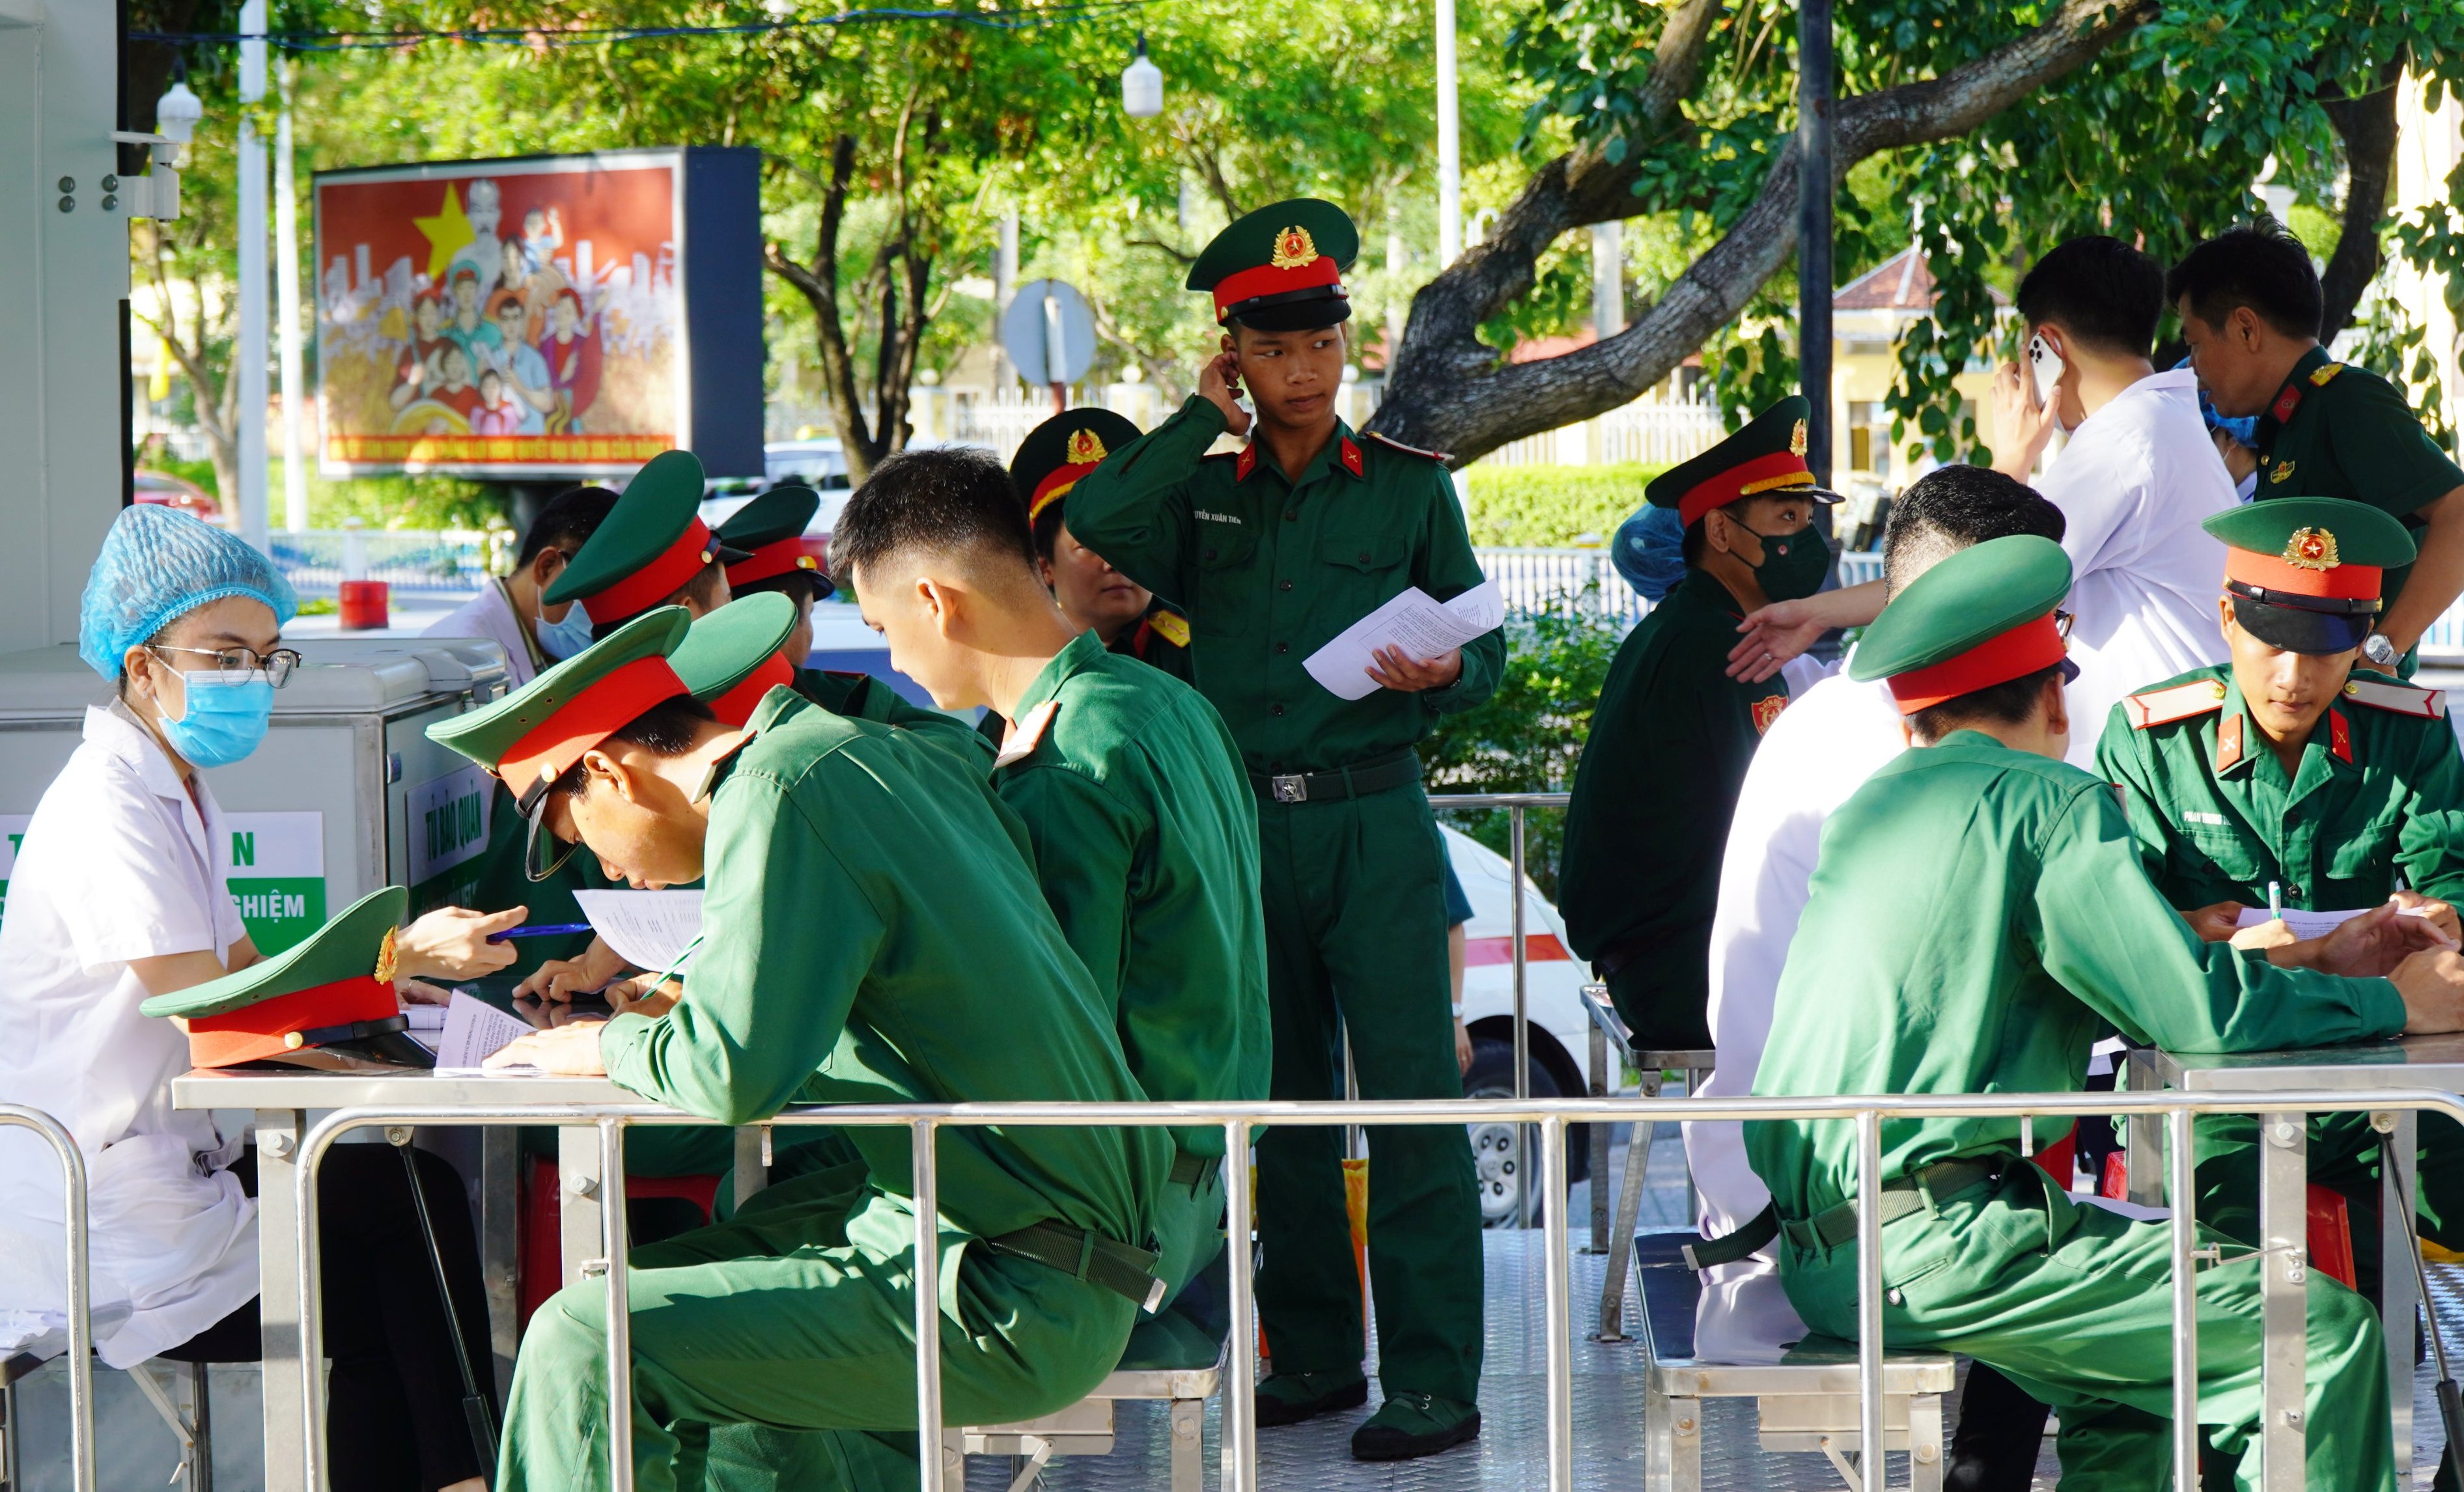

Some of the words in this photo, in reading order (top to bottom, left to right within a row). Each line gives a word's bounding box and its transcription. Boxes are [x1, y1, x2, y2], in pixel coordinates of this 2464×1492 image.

[1211, 512, 1227, 523] XUÂN
[425, 793, 437, 861] TỦ
[439, 788, 456, 856] BẢO
[458, 779, 482, 851] QUẢN
[2184, 811, 2201, 823] PHAN
